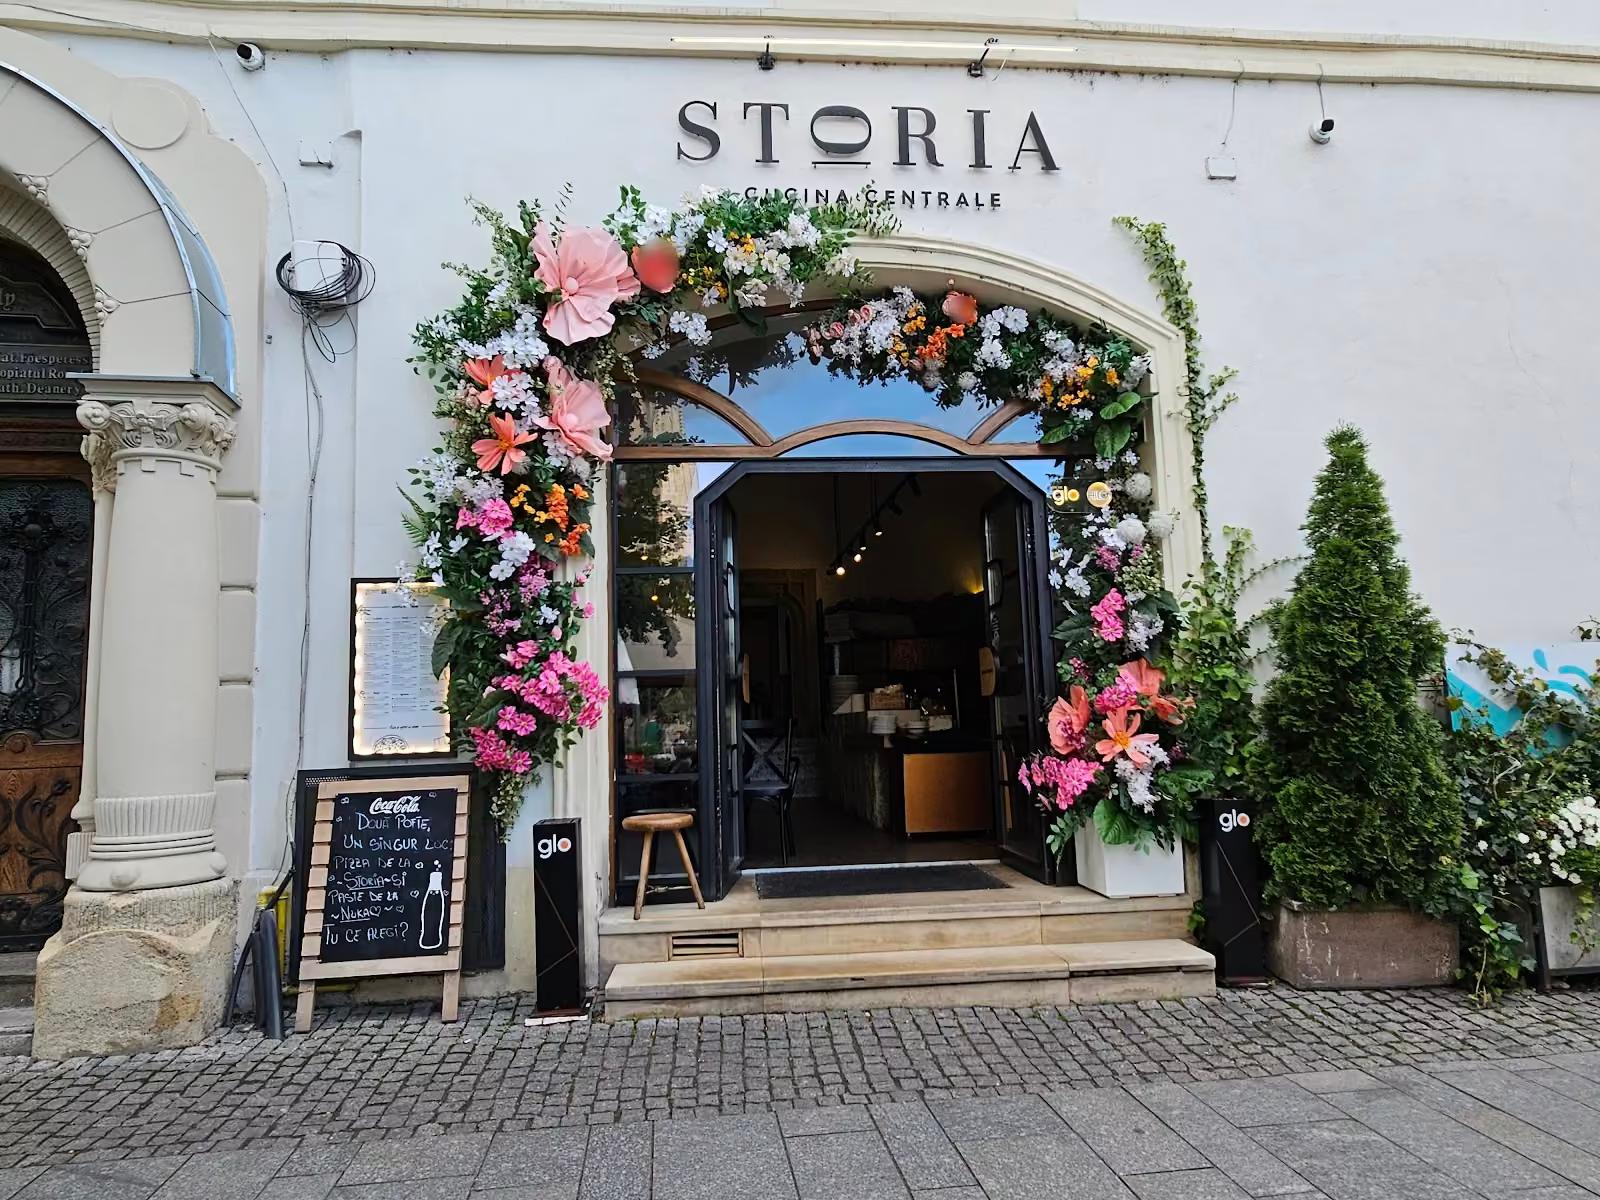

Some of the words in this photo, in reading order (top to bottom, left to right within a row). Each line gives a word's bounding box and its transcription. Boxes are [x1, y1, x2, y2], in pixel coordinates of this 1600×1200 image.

[677, 100, 1062, 171] STORIA
[865, 189, 1001, 208] CENTRALE
[1051, 485, 1080, 506] glo
[1218, 808, 1250, 833] glo
[343, 833, 363, 849] UN
[369, 836, 418, 852] SINGUR
[537, 833, 572, 859] glo
[333, 856, 370, 870] PIZZA
[378, 856, 395, 869] DE
[398, 857, 411, 868] LA
[328, 889, 365, 905] PASTE
[368, 890, 384, 902] DE
[386, 890, 399, 901] LA
[345, 928, 362, 943] CE
